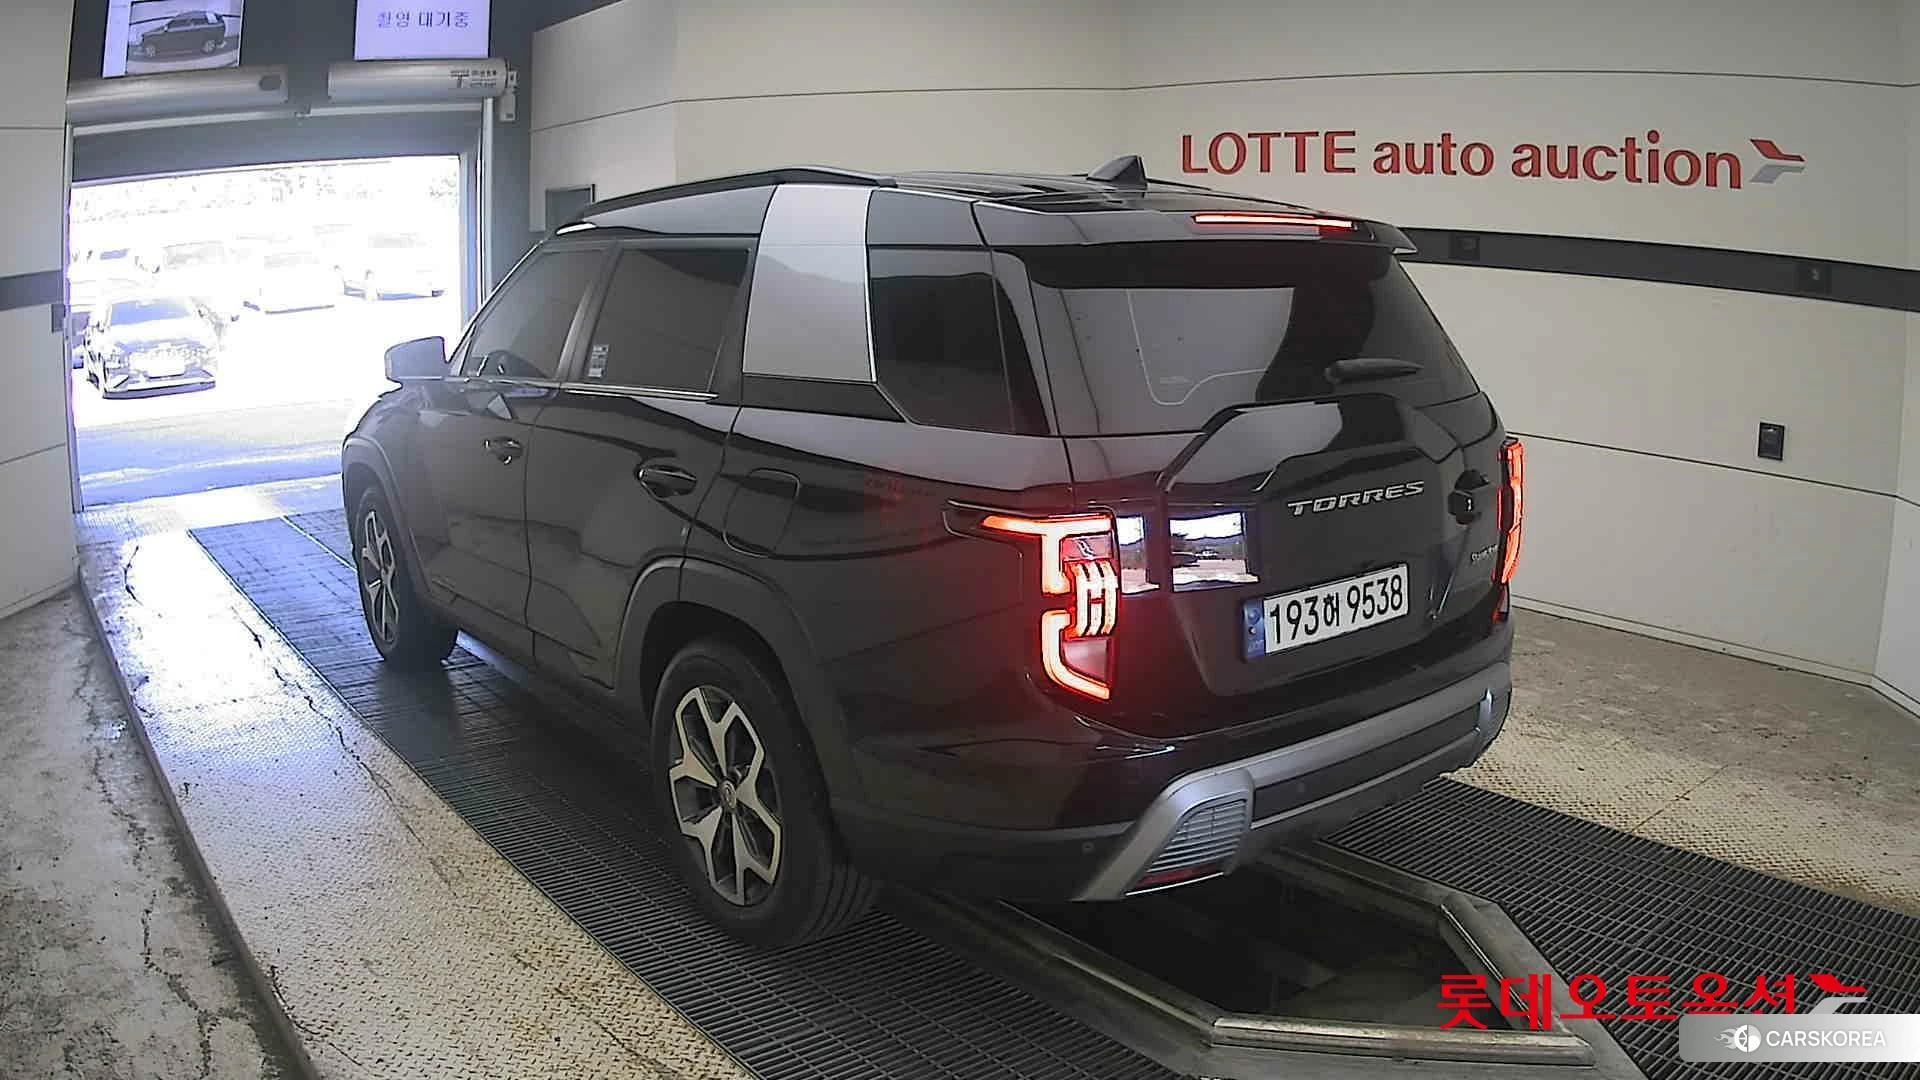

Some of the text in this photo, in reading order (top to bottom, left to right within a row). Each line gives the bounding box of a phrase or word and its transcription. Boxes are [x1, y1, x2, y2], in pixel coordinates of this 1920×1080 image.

[418, 11, 471, 28] 대기중
[1182, 129, 1742, 189] LOTTE auto auction
[1288, 481, 1424, 516] TORRES
[1270, 574, 1403, 644] 193허 9538
